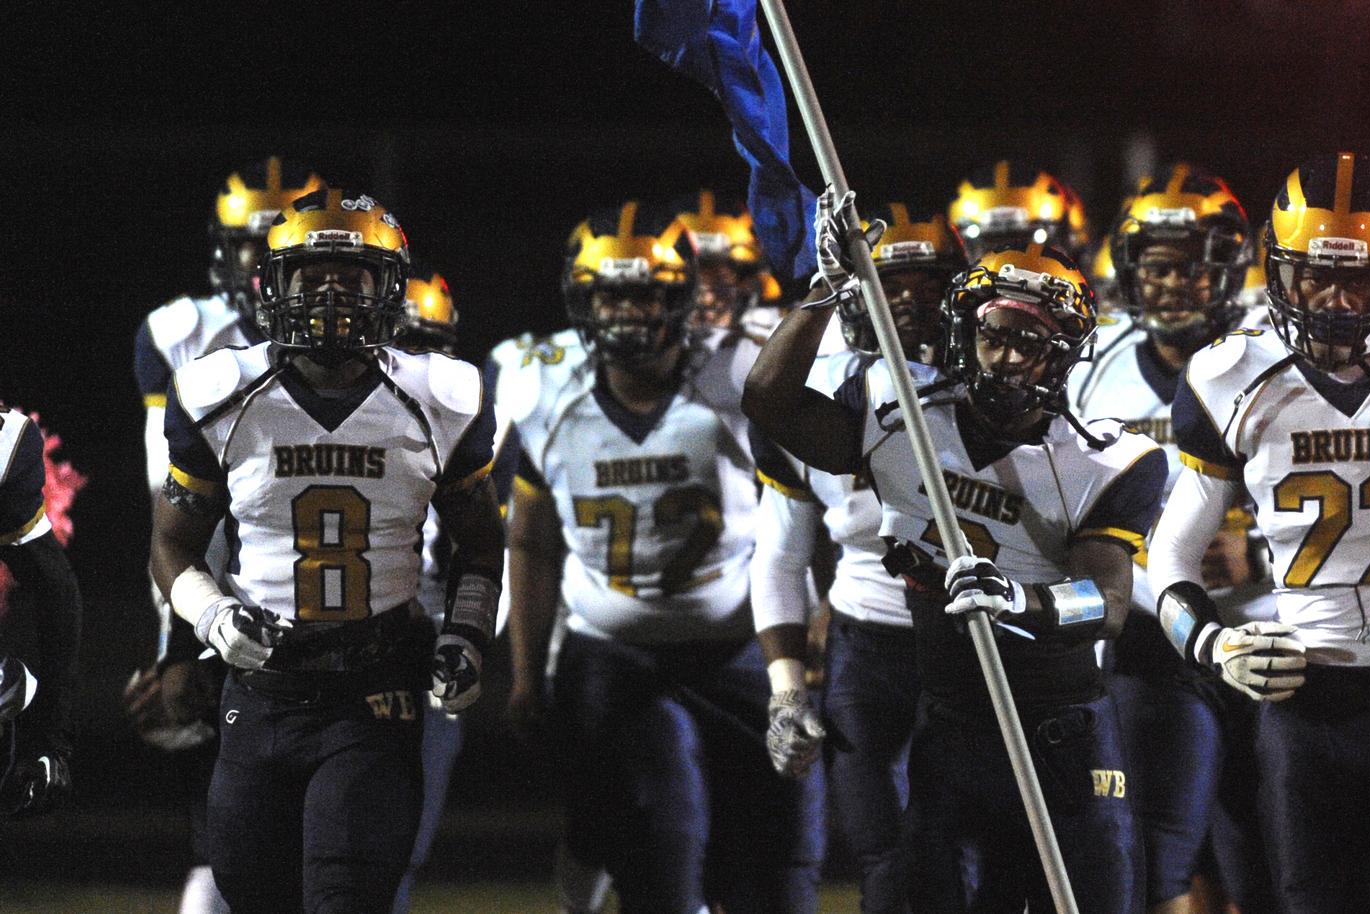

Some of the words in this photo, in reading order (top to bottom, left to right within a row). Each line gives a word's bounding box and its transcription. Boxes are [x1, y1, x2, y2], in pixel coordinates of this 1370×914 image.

[317, 232, 350, 241] Riddell
[1322, 240, 1355, 251] Riddell
[272, 444, 384, 479] BRUINS
[594, 453, 690, 488] BRUINS
[919, 468, 1023, 526] RUINS
[291, 484, 371, 622] 8
[572, 492, 724, 600] 72
[1091, 768, 1127, 799] WB
